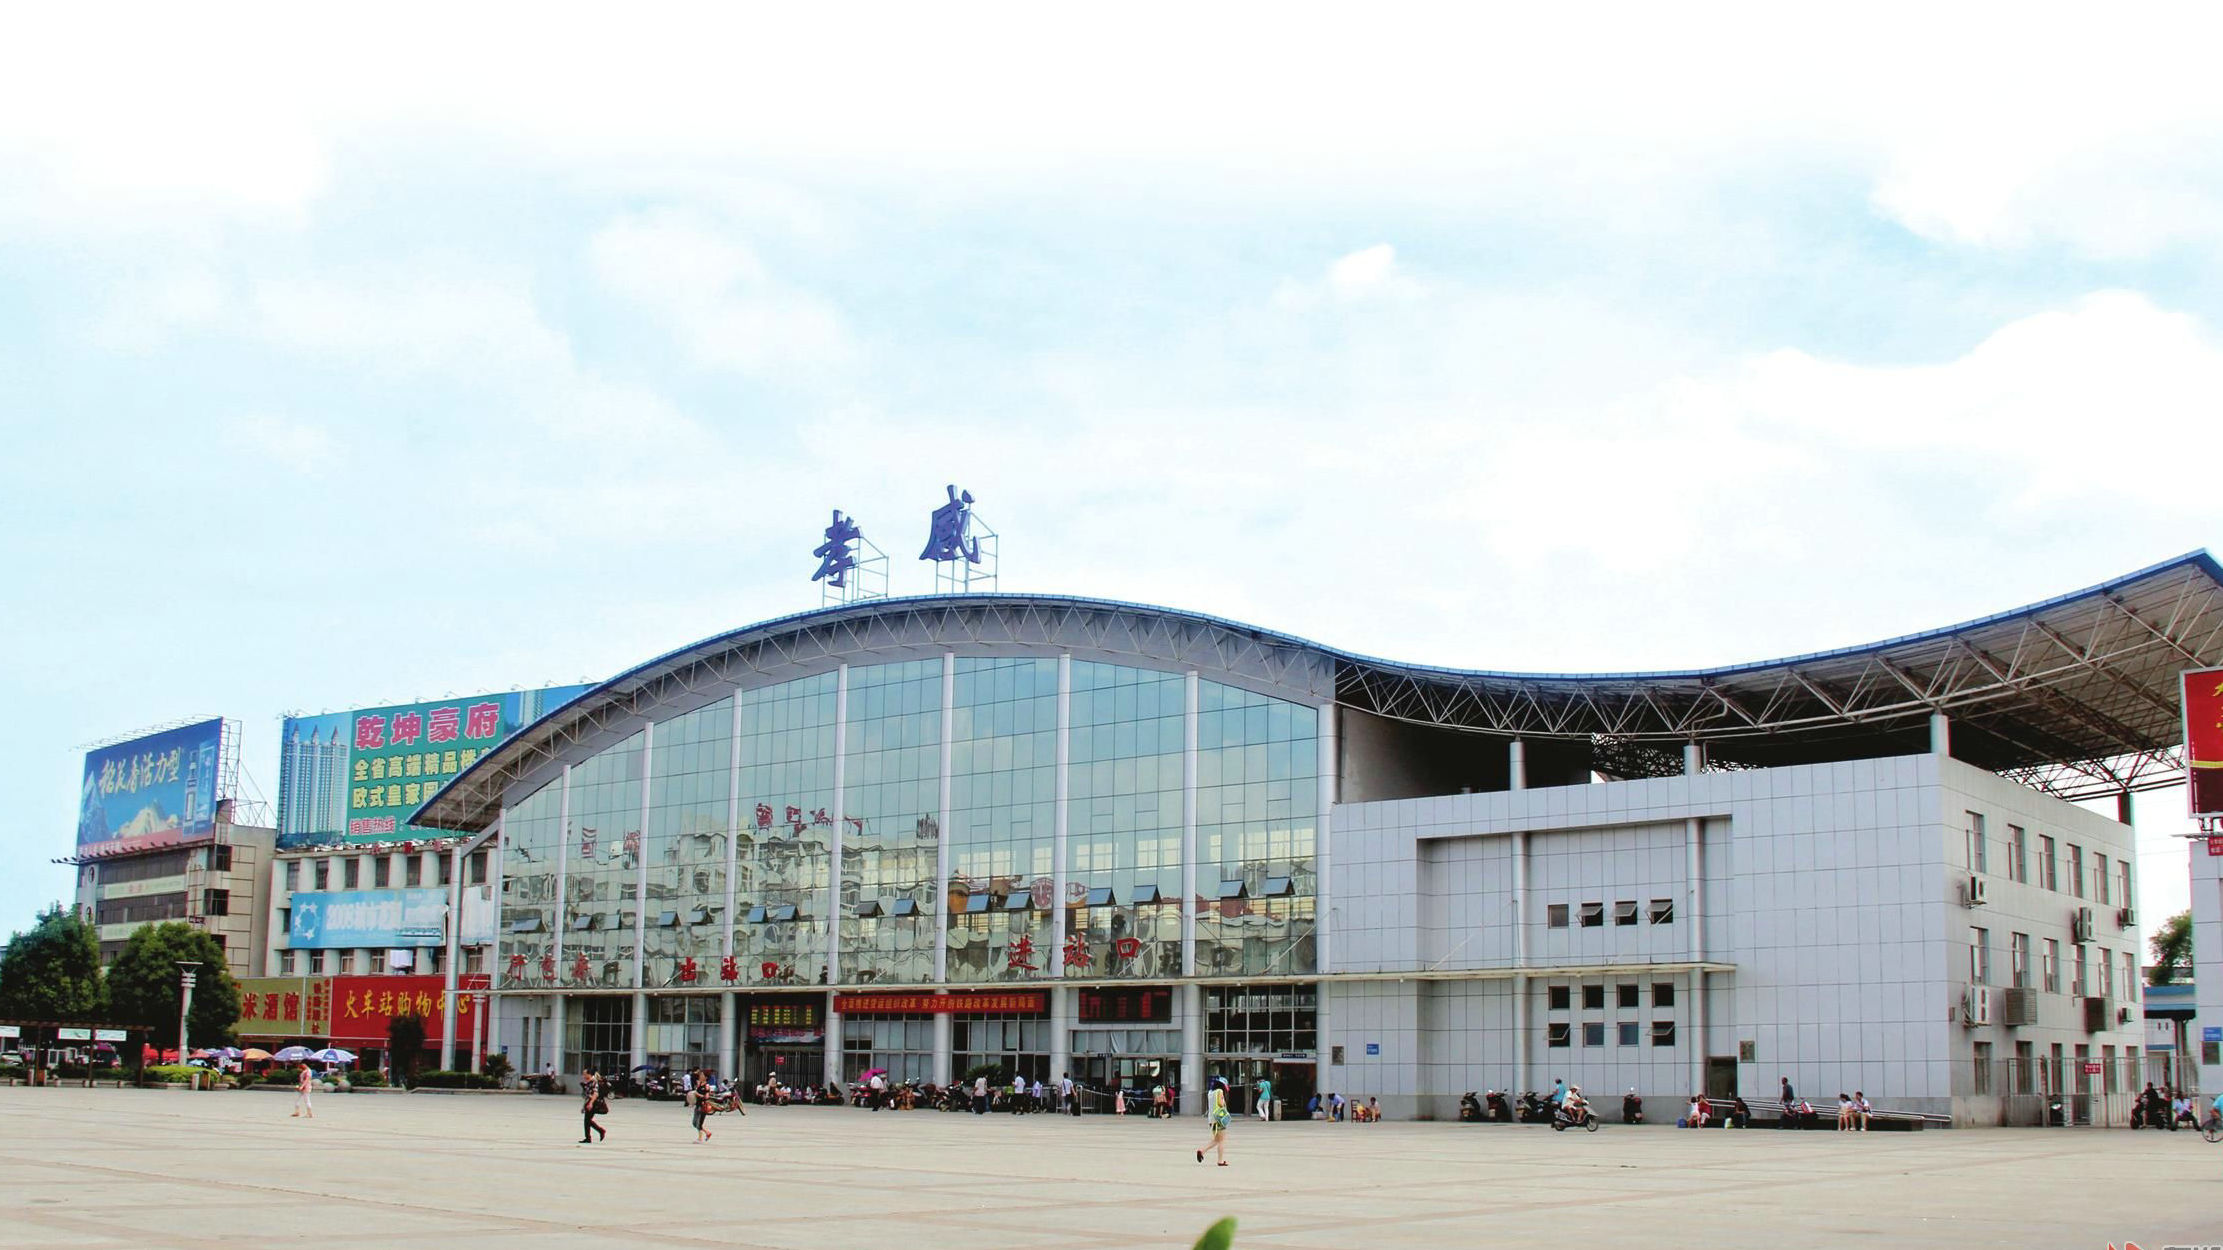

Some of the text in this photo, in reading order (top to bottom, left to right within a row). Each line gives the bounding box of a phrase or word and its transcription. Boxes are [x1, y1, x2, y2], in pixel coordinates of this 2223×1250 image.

[811, 484, 982, 588] 孝感
[354, 702, 500, 750] 乾坤豪府
[353, 747, 492, 781] 全省高端精品楼
[352, 780, 449, 809] 欧式皇家园
[1008, 932, 1140, 970] 进站口
[678, 956, 778, 982] 出站口
[344, 989, 471, 1020] 火车站购物中心
